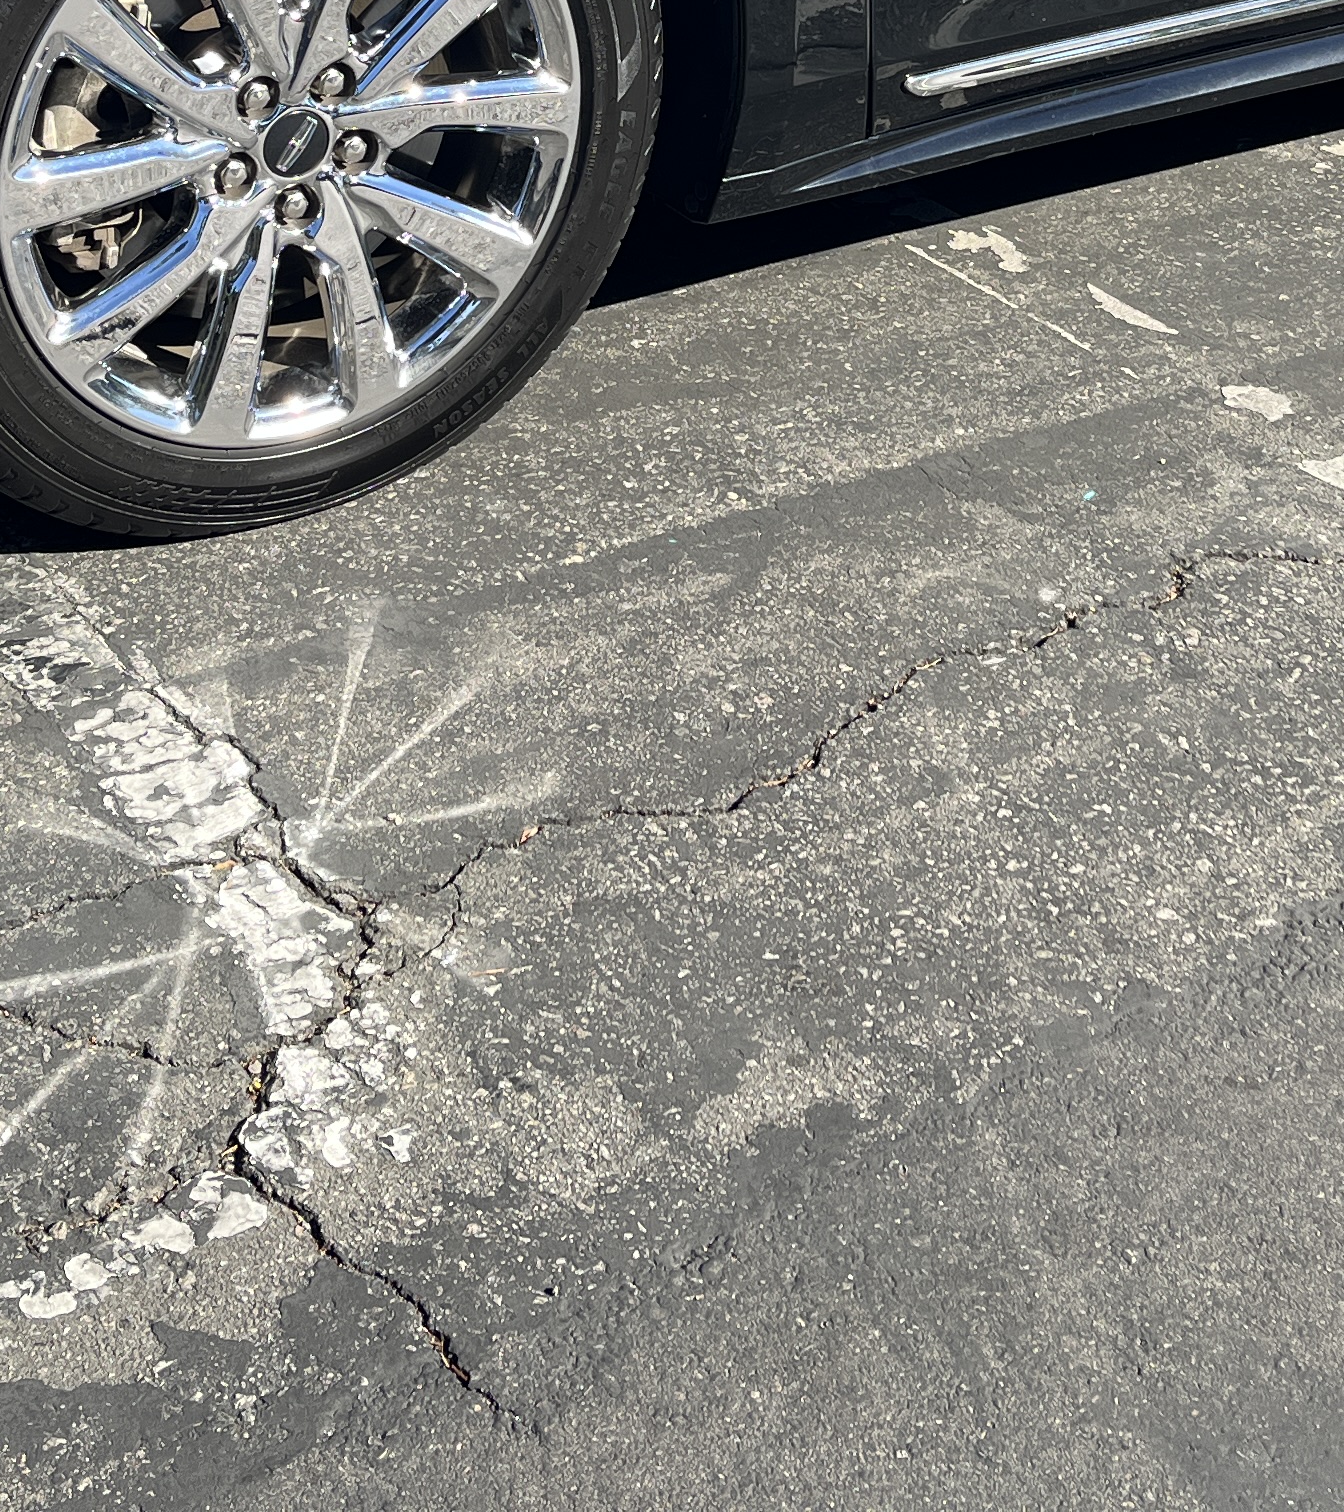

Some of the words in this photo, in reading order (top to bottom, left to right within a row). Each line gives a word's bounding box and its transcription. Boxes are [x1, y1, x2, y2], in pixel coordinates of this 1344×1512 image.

[598, 109, 638, 222] EAGLE
[516, 317, 549, 359] ALL
[432, 366, 511, 438] SEASON
